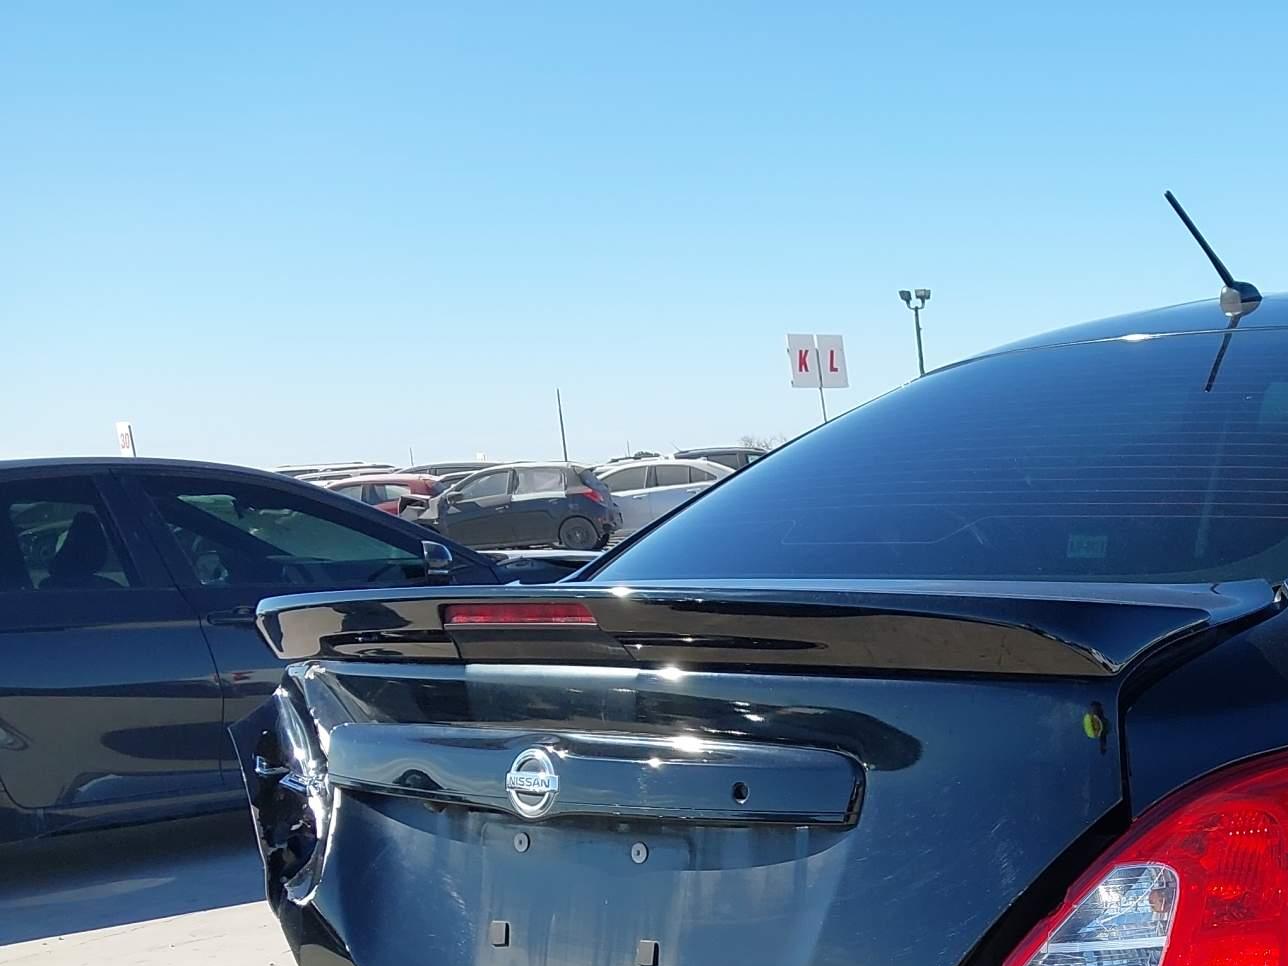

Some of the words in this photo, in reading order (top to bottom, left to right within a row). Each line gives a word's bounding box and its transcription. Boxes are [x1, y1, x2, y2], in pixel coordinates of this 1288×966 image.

[798, 349, 809, 373] K
[829, 349, 839, 373] L
[509, 776, 550, 788] NISSAN
